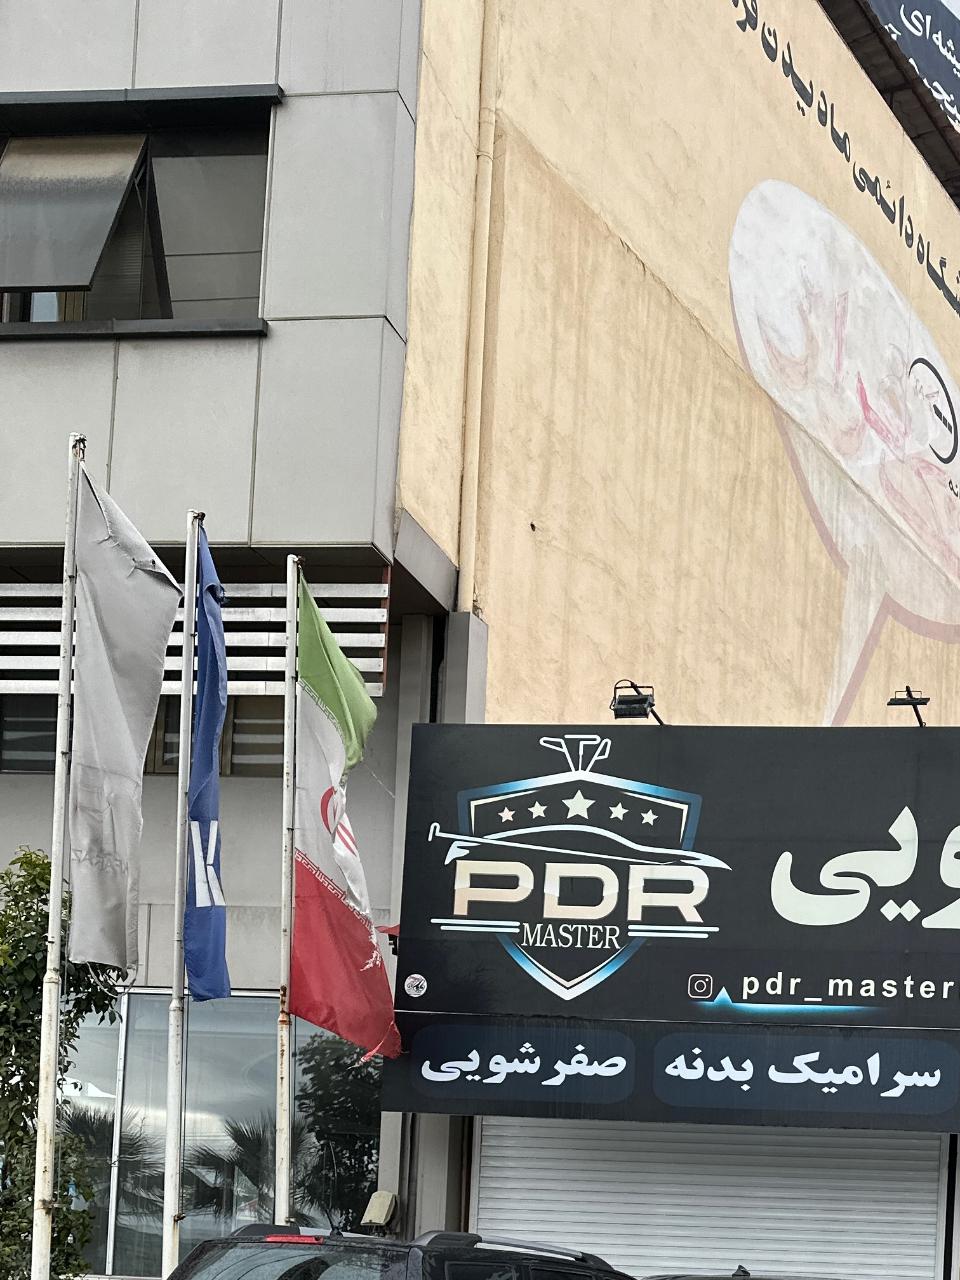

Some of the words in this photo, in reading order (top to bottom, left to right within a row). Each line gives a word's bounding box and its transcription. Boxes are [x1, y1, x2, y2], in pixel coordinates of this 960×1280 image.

[453, 859, 711, 923] PDR
[521, 922, 621, 950] MASTER
[664, 1047, 754, 1092] بدنه
[767, 1051, 941, 1098] سرامیک
